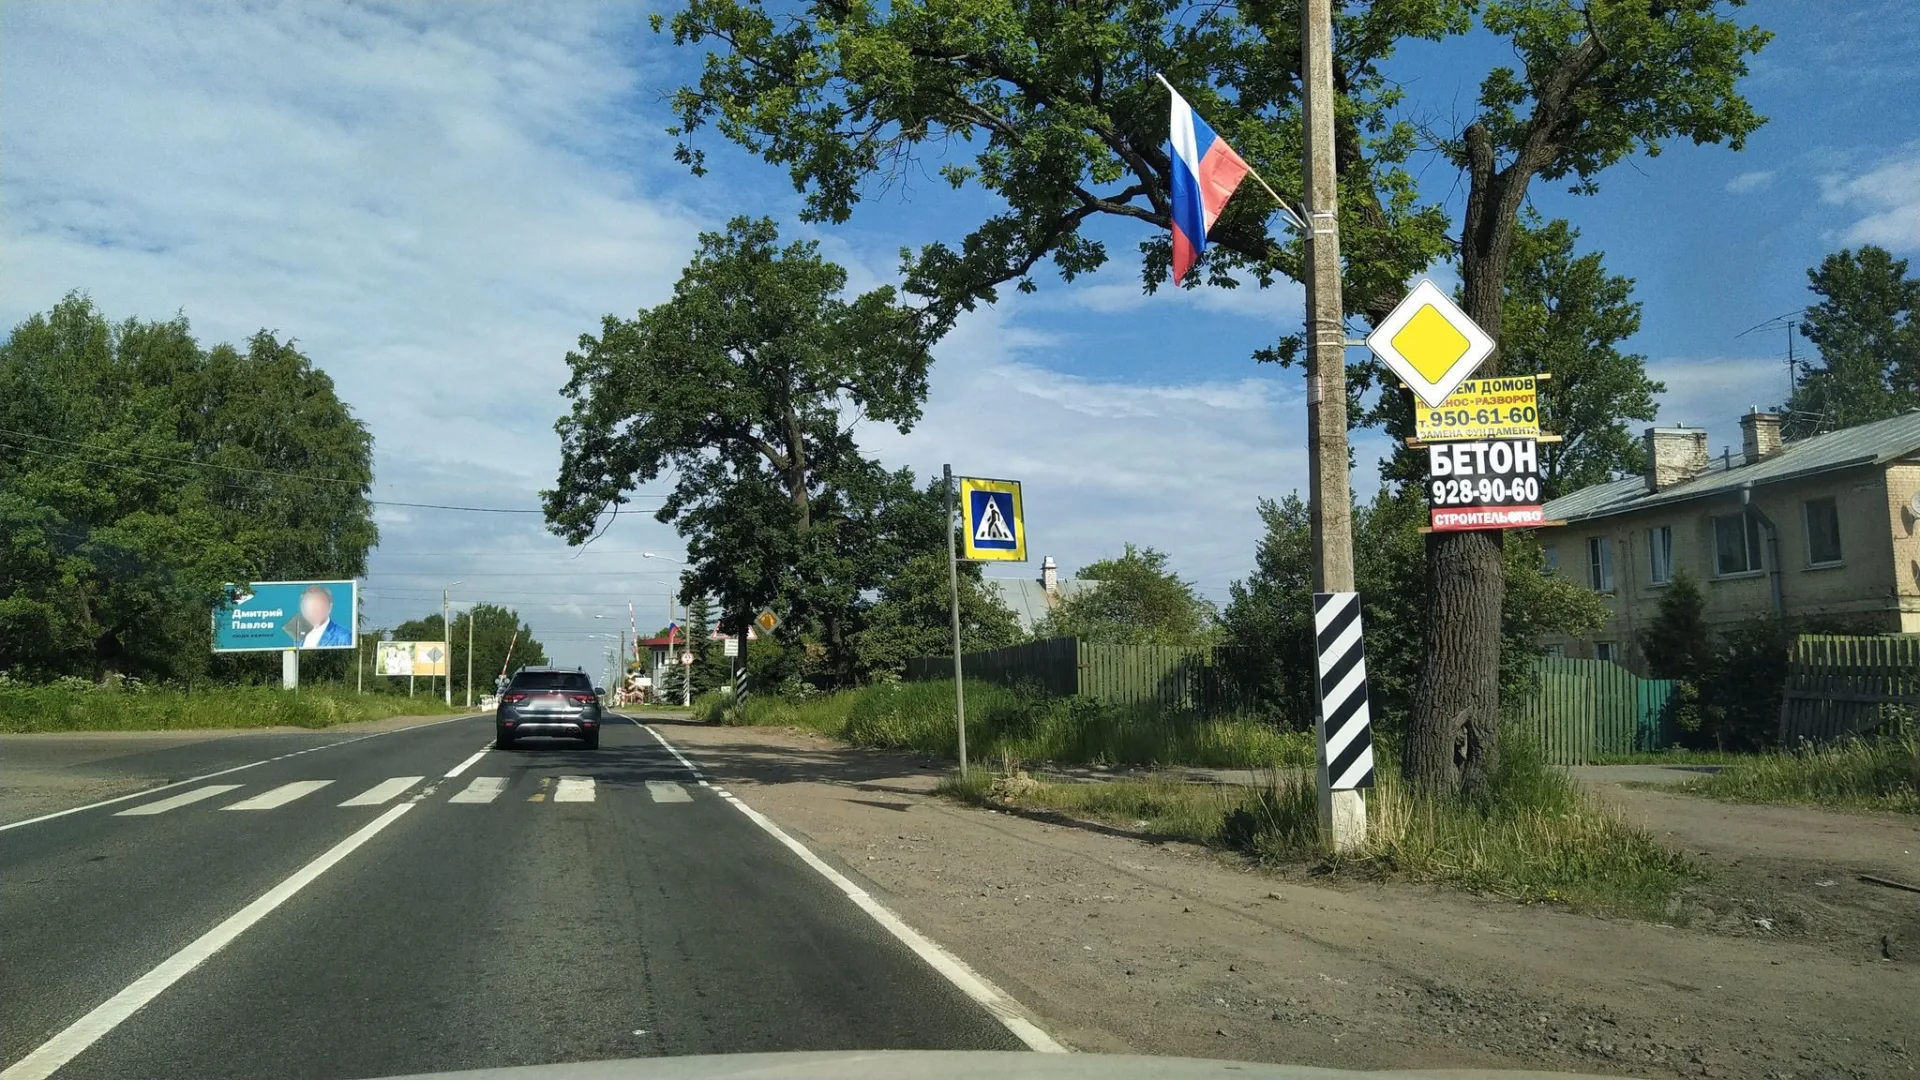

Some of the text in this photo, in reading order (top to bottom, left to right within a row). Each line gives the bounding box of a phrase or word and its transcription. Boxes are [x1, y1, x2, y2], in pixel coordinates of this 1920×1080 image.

[1481, 379, 1534, 395] ДОМОВ
[1475, 394, 1535, 406] РАЗВОРОТ
[1430, 406, 1536, 427] 950-61-60
[1420, 426, 1539, 439] ЗАМЕНА ФУНДАМЕНТА
[1429, 441, 1537, 477] БЕТОН
[1432, 477, 1539, 505] 928-90-60
[232, 608, 283, 620] Дмитрий
[232, 620, 274, 630] Павлов
